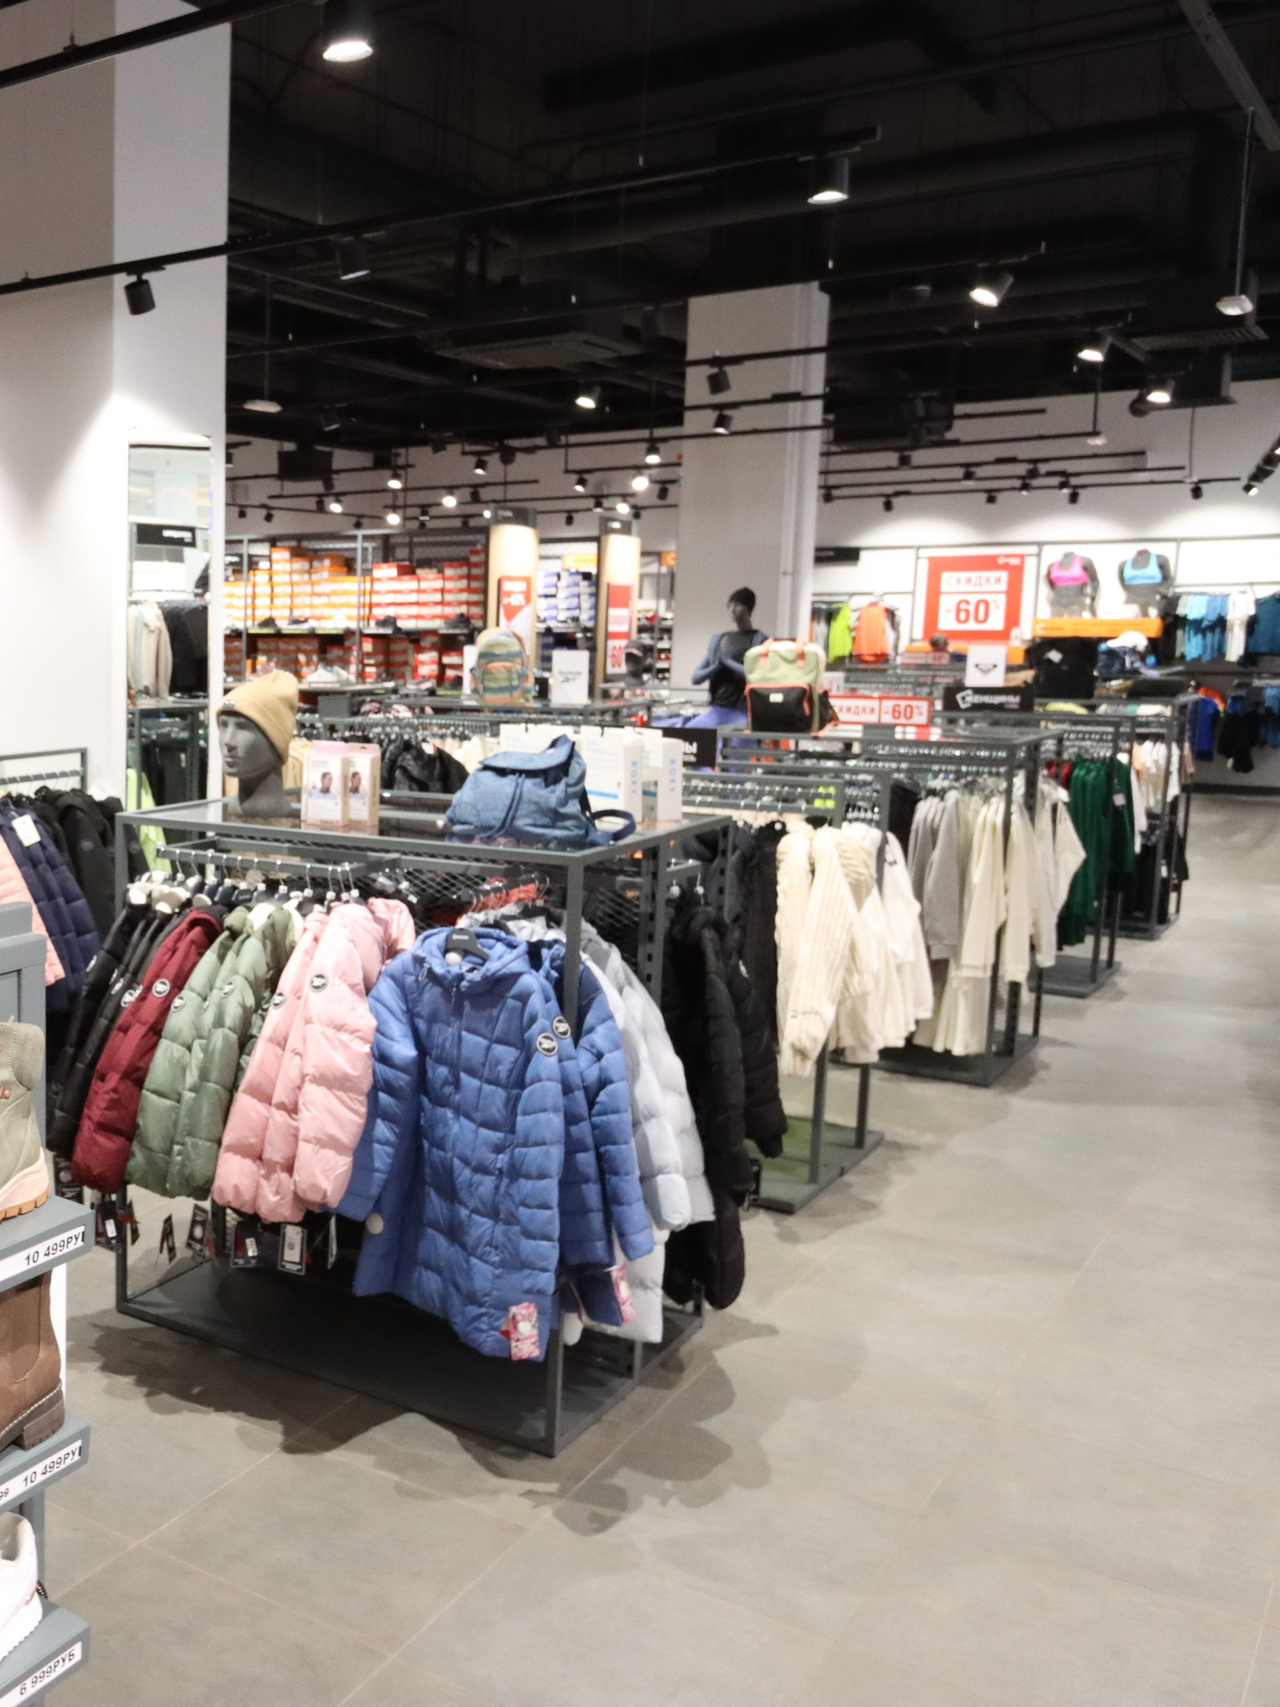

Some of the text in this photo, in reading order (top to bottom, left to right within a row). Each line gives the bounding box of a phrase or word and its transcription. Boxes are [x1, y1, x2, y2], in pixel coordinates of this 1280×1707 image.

[946, 575, 1003, 588] СКИДКИ
[835, 706, 875, 719] КИДКИ
[24, 1252, 40, 1267] 10
[22, 1471, 37, 1488] 10
[19, 1648, 76, 1696] 6 999РУБ
